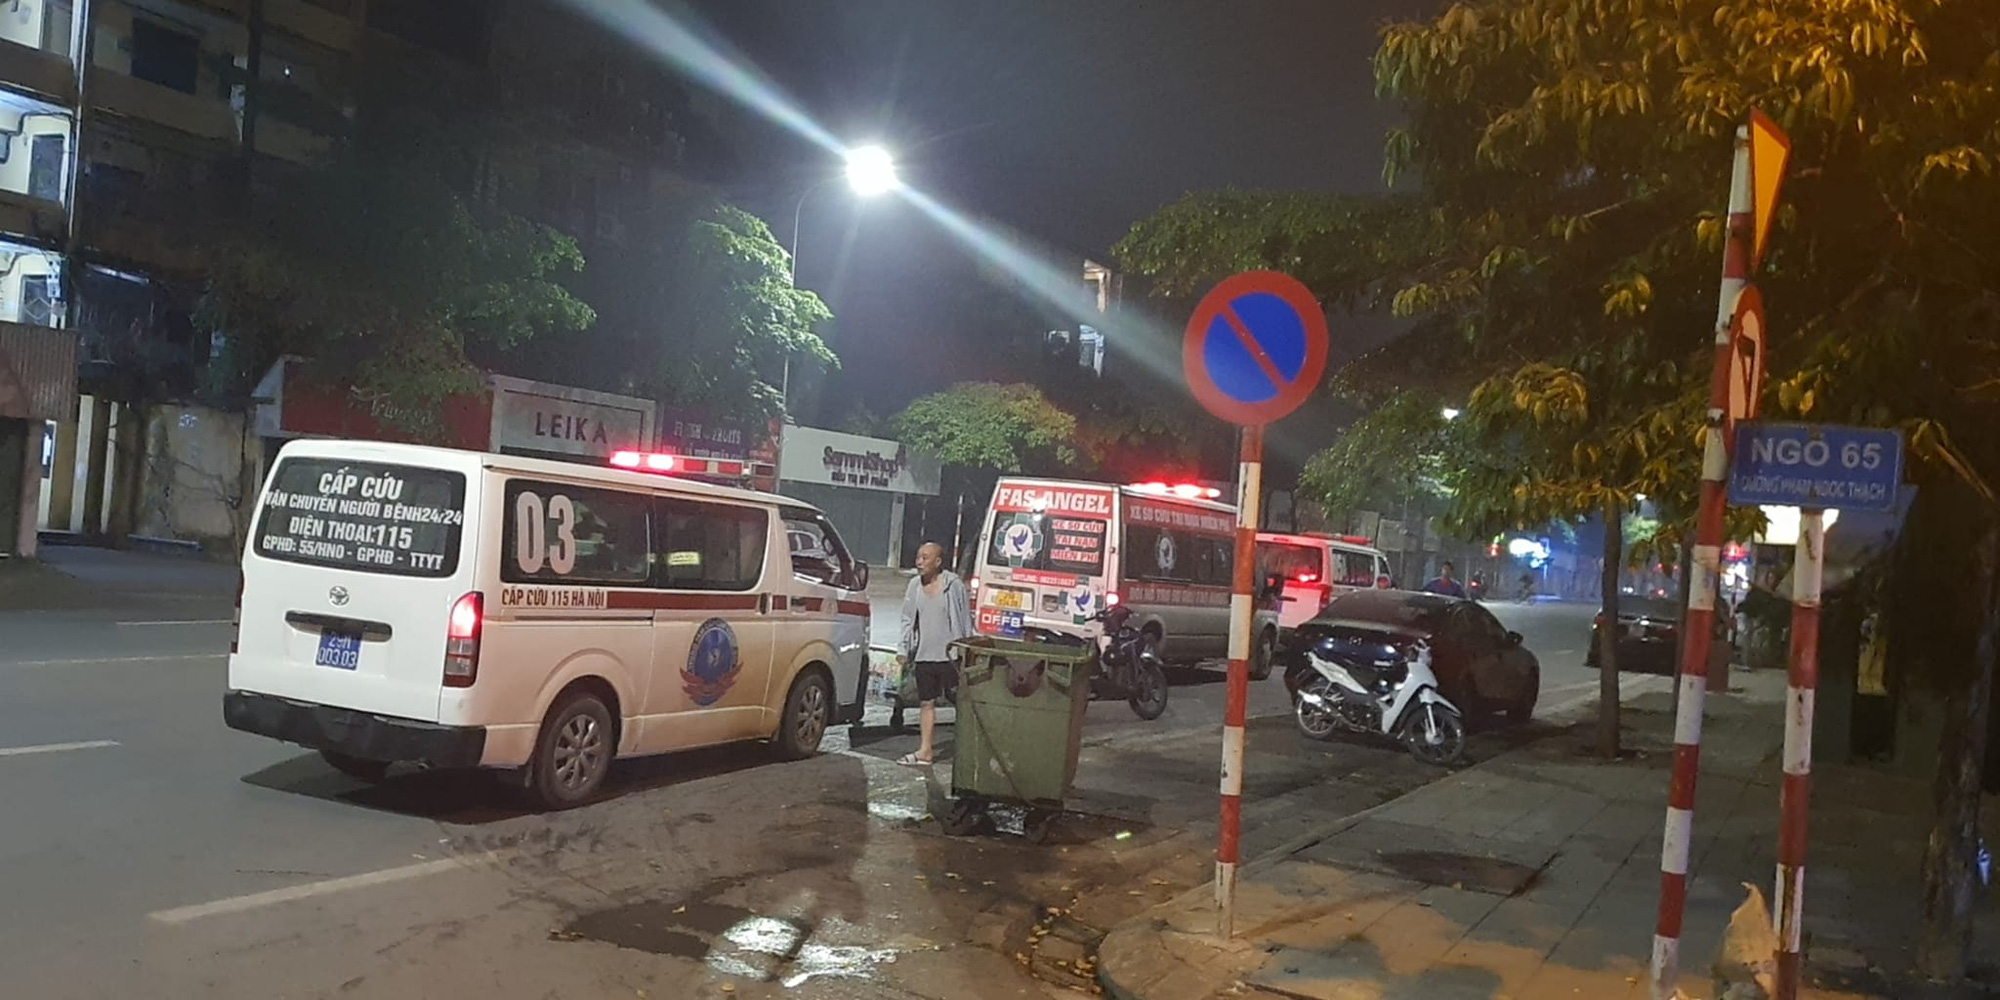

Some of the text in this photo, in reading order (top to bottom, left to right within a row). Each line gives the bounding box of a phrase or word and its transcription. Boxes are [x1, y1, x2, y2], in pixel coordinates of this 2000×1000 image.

[535, 411, 608, 444] LEIKA
[1841, 442, 1883, 470] 65
[318, 466, 404, 500] CẤP CỨU
[1041, 491, 1111, 514] ANGEL
[288, 514, 325, 539] ĐIỆN
[516, 491, 576, 574] 03
[410, 552, 444, 570] TTYT
[501, 586, 524, 606] CẤP
[551, 590, 570, 606] 115
[571, 588, 585, 607] HÀ
[586, 588, 605, 609] NỘI
